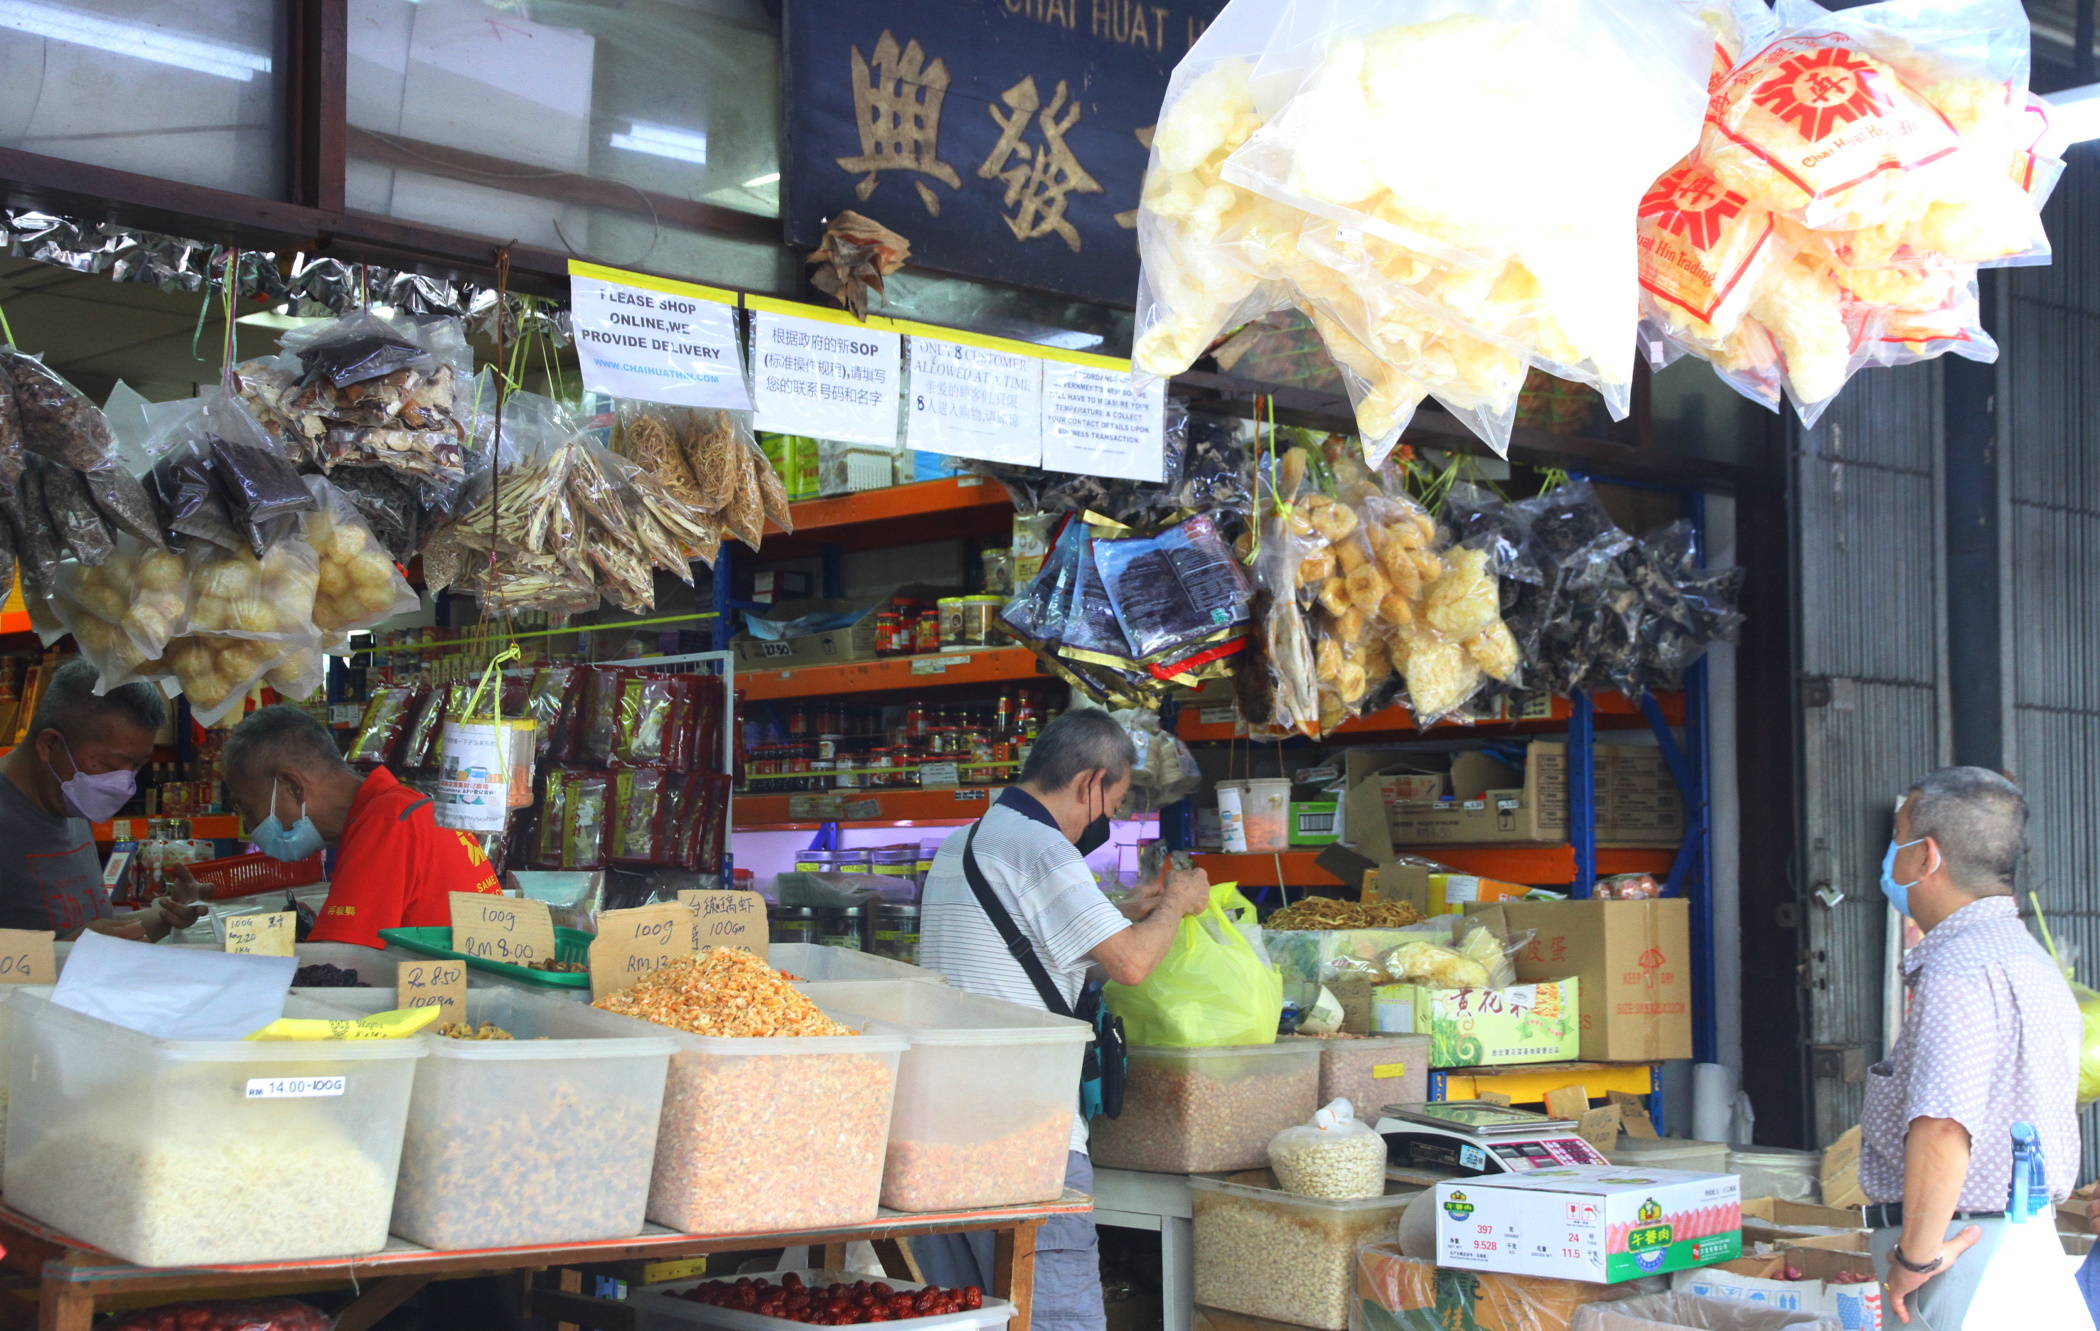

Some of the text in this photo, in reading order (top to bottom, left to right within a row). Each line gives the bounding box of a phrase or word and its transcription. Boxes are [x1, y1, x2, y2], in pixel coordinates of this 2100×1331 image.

[1092, 0, 1169, 53] HUAT
[1802, 143, 1836, 168] Chai
[1655, 240, 1677, 262] Hin
[1677, 250, 1717, 288] Trading
[659, 299, 697, 315] SHOP
[581, 328, 721, 360] PROVIDE DELIVERY
[772, 326, 880, 357] 根据政府的新SOP
[920, 341, 1028, 372] ONLY 8 CUSTOMER
[593, 357, 720, 384] WWW.CHAIHUATHIN.COM
[914, 360, 972, 380] ALLOWED
[974, 370, 991, 384] AT
[1003, 375, 1032, 392] TIME
[766, 375, 883, 408] 您的联系号码和名字
[1068, 393, 1085, 403] HAVE
[1088, 396, 1096, 405] TO
[1055, 403, 1103, 418] TEMPERATURE
[1113, 412, 1142, 422] COLLECT
[1047, 415, 1150, 434] YOUR CONTACT DETAILS UPON
[764, 643, 790, 657] 27.50
[230, 917, 254, 929] 100G
[482, 906, 516, 932] 100g
[635, 920, 674, 945] 100g
[465, 936, 534, 959] RM 8.00
[431, 966, 461, 985] 8.50
[1623, 972, 1675, 985] KEEP DRY
[249, 1088, 264, 1096] RM
[1477, 1224, 1493, 1235] 397
[1568, 1232, 1580, 1243] 24
[1631, 1227, 1671, 1247] 午餐肉
[1473, 1239, 1498, 1251] 9.528
[1562, 1248, 1581, 1259] 11.5
